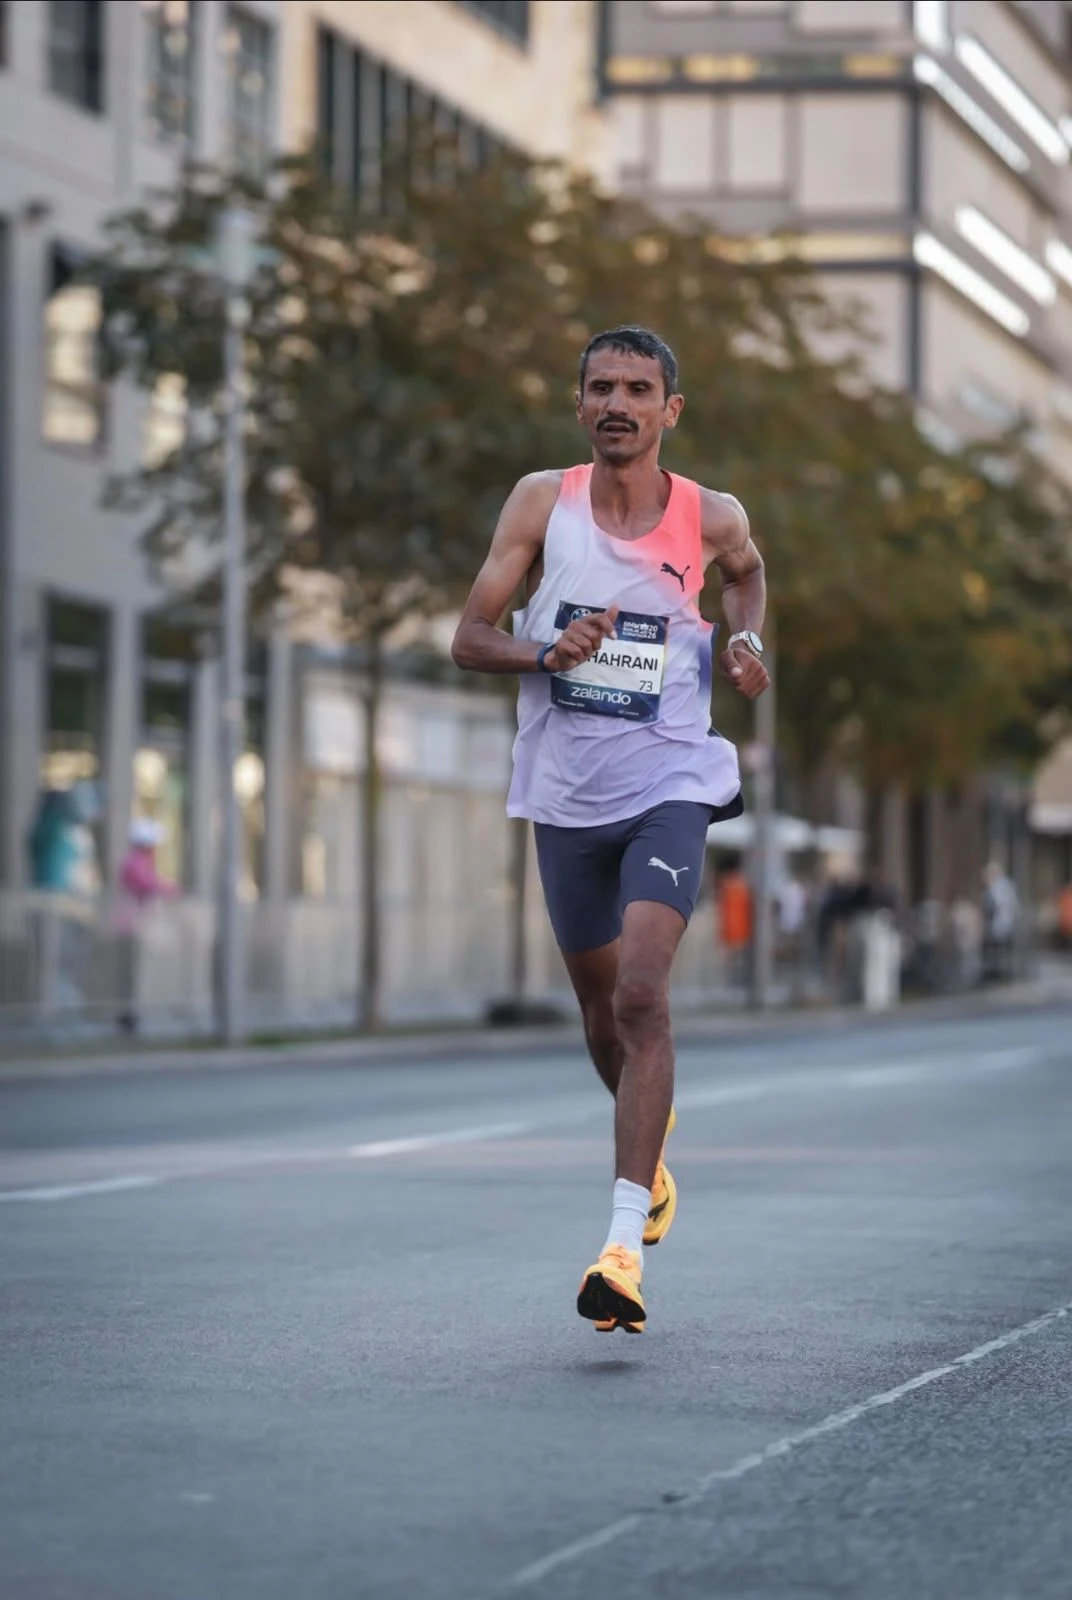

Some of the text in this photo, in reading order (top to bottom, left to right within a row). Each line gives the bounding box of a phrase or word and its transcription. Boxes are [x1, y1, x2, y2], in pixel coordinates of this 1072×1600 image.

[648, 624, 659, 632] 20
[639, 680, 653, 692] 73
[571, 686, 631, 705] zalando
